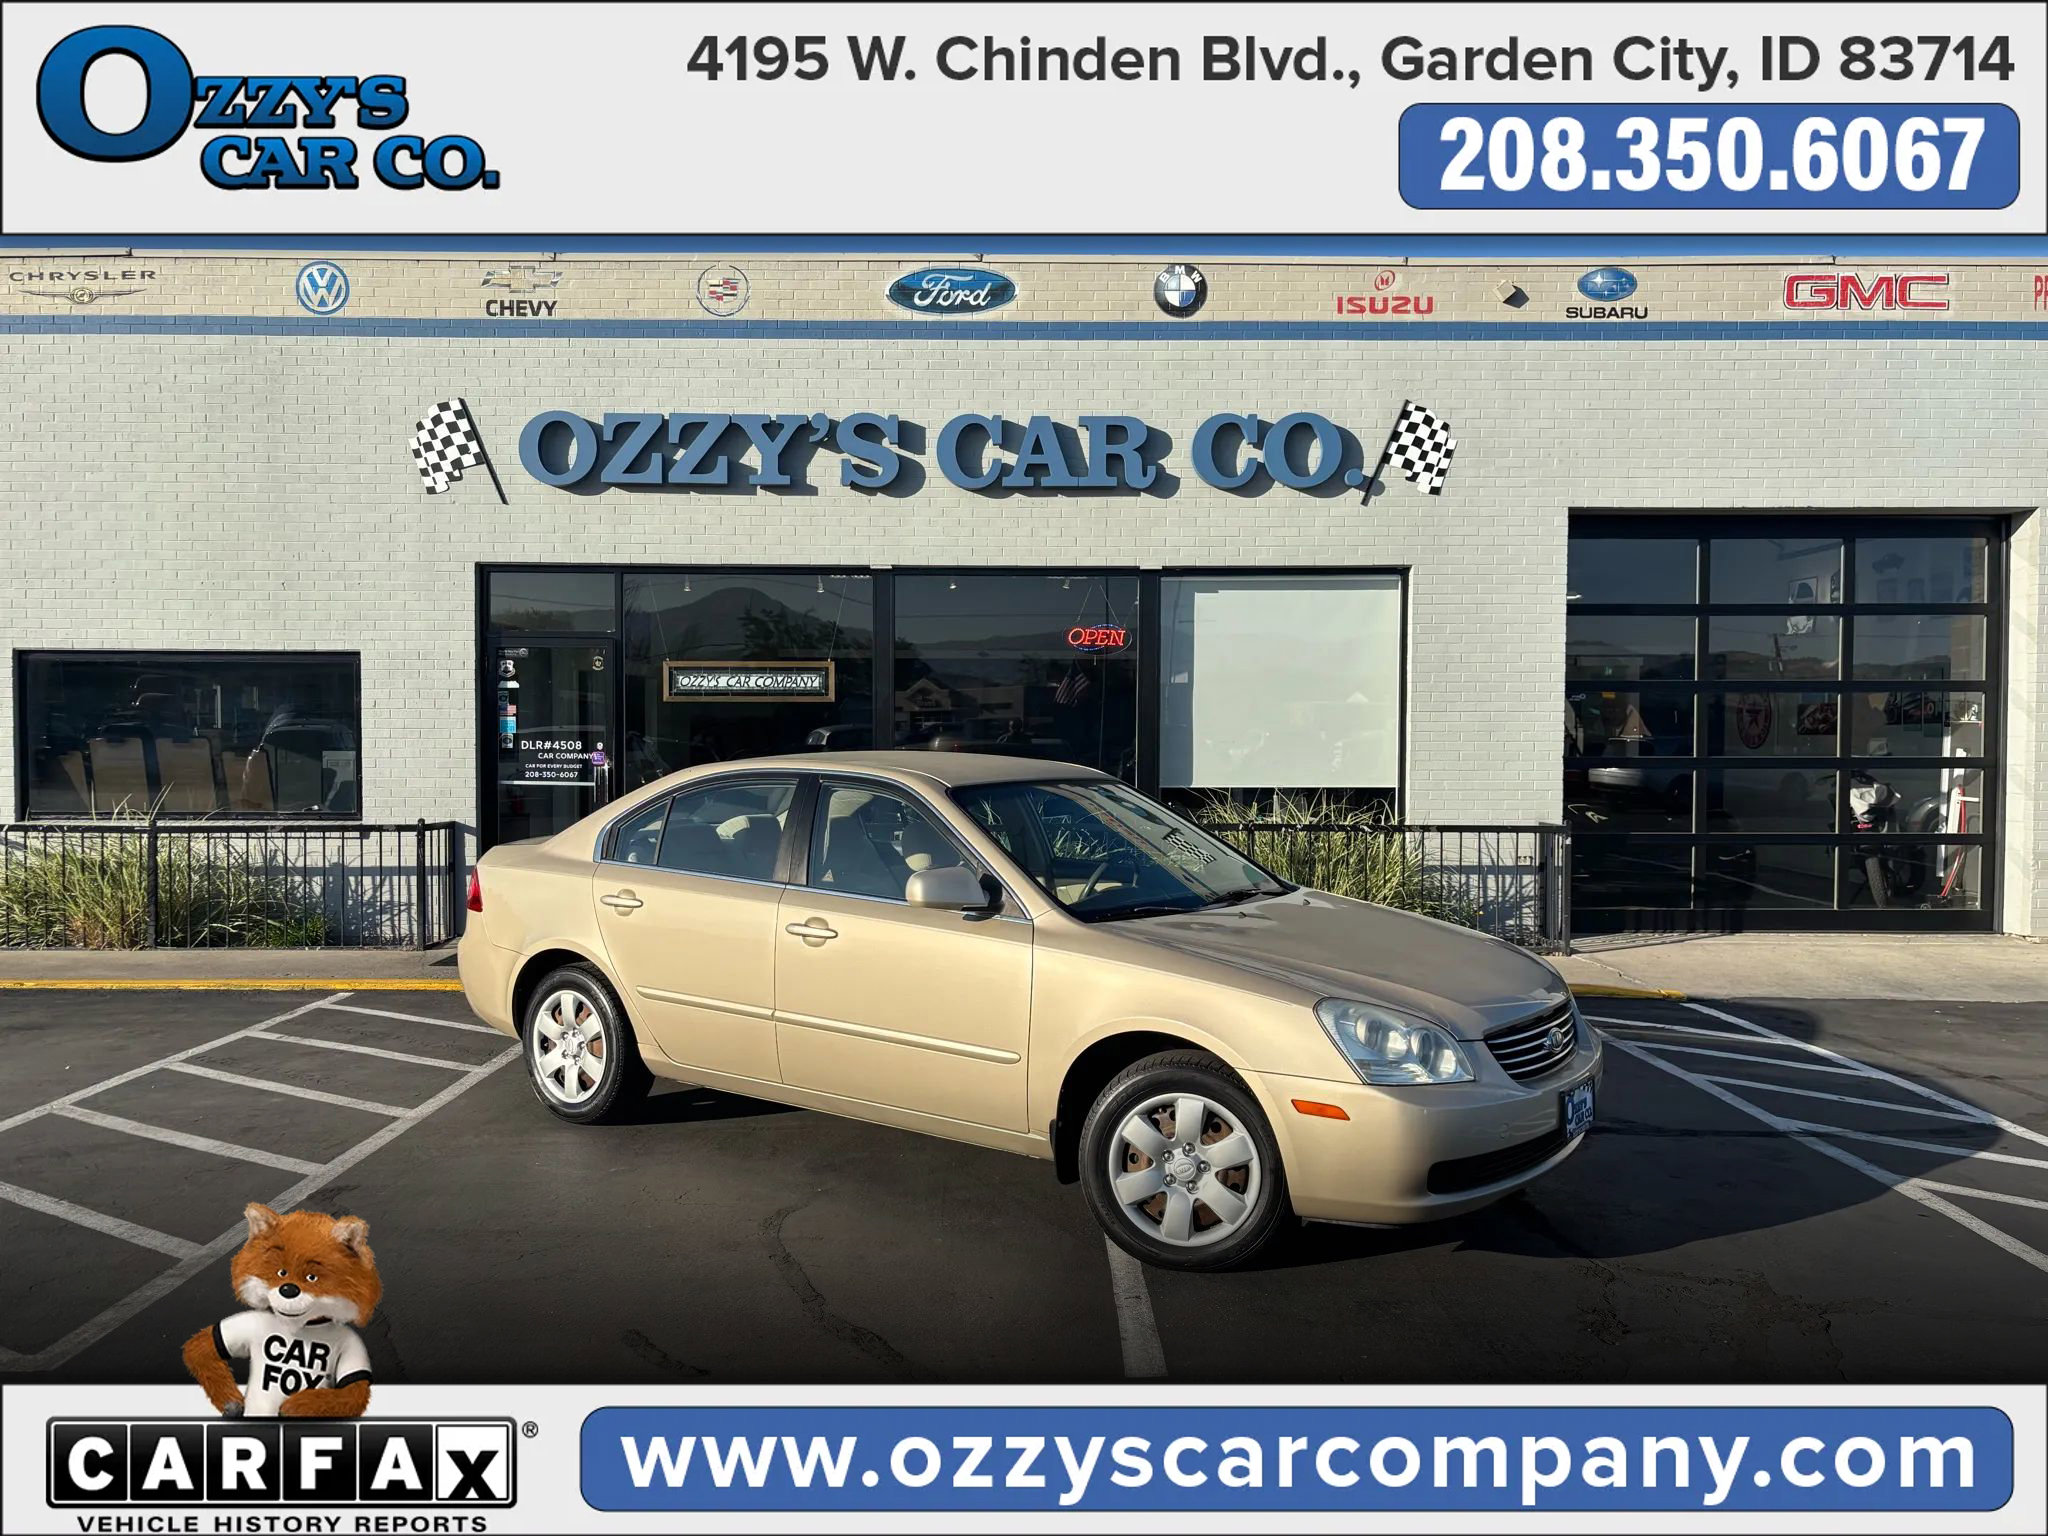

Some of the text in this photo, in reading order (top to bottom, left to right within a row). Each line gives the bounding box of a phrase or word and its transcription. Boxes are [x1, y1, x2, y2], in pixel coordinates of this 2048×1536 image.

[9, 270, 157, 282] CHRYSLER
[1158, 264, 1203, 284] BMW
[914, 273, 993, 307] Ford
[1784, 273, 1949, 310] GMC
[486, 299, 558, 317] CHEVY
[1337, 296, 1434, 314] ISUZU
[1566, 307, 1649, 319] SUBARU
[518, 410, 1364, 490] OZZY'S CAR CO.
[1068, 628, 1126, 646] OPEN
[680, 675, 818, 687] OZZY'S CAR COMPANY
[521, 740, 582, 750] DLR#4508
[538, 752, 554, 760] CAR
[555, 752, 593, 760] COMPANY
